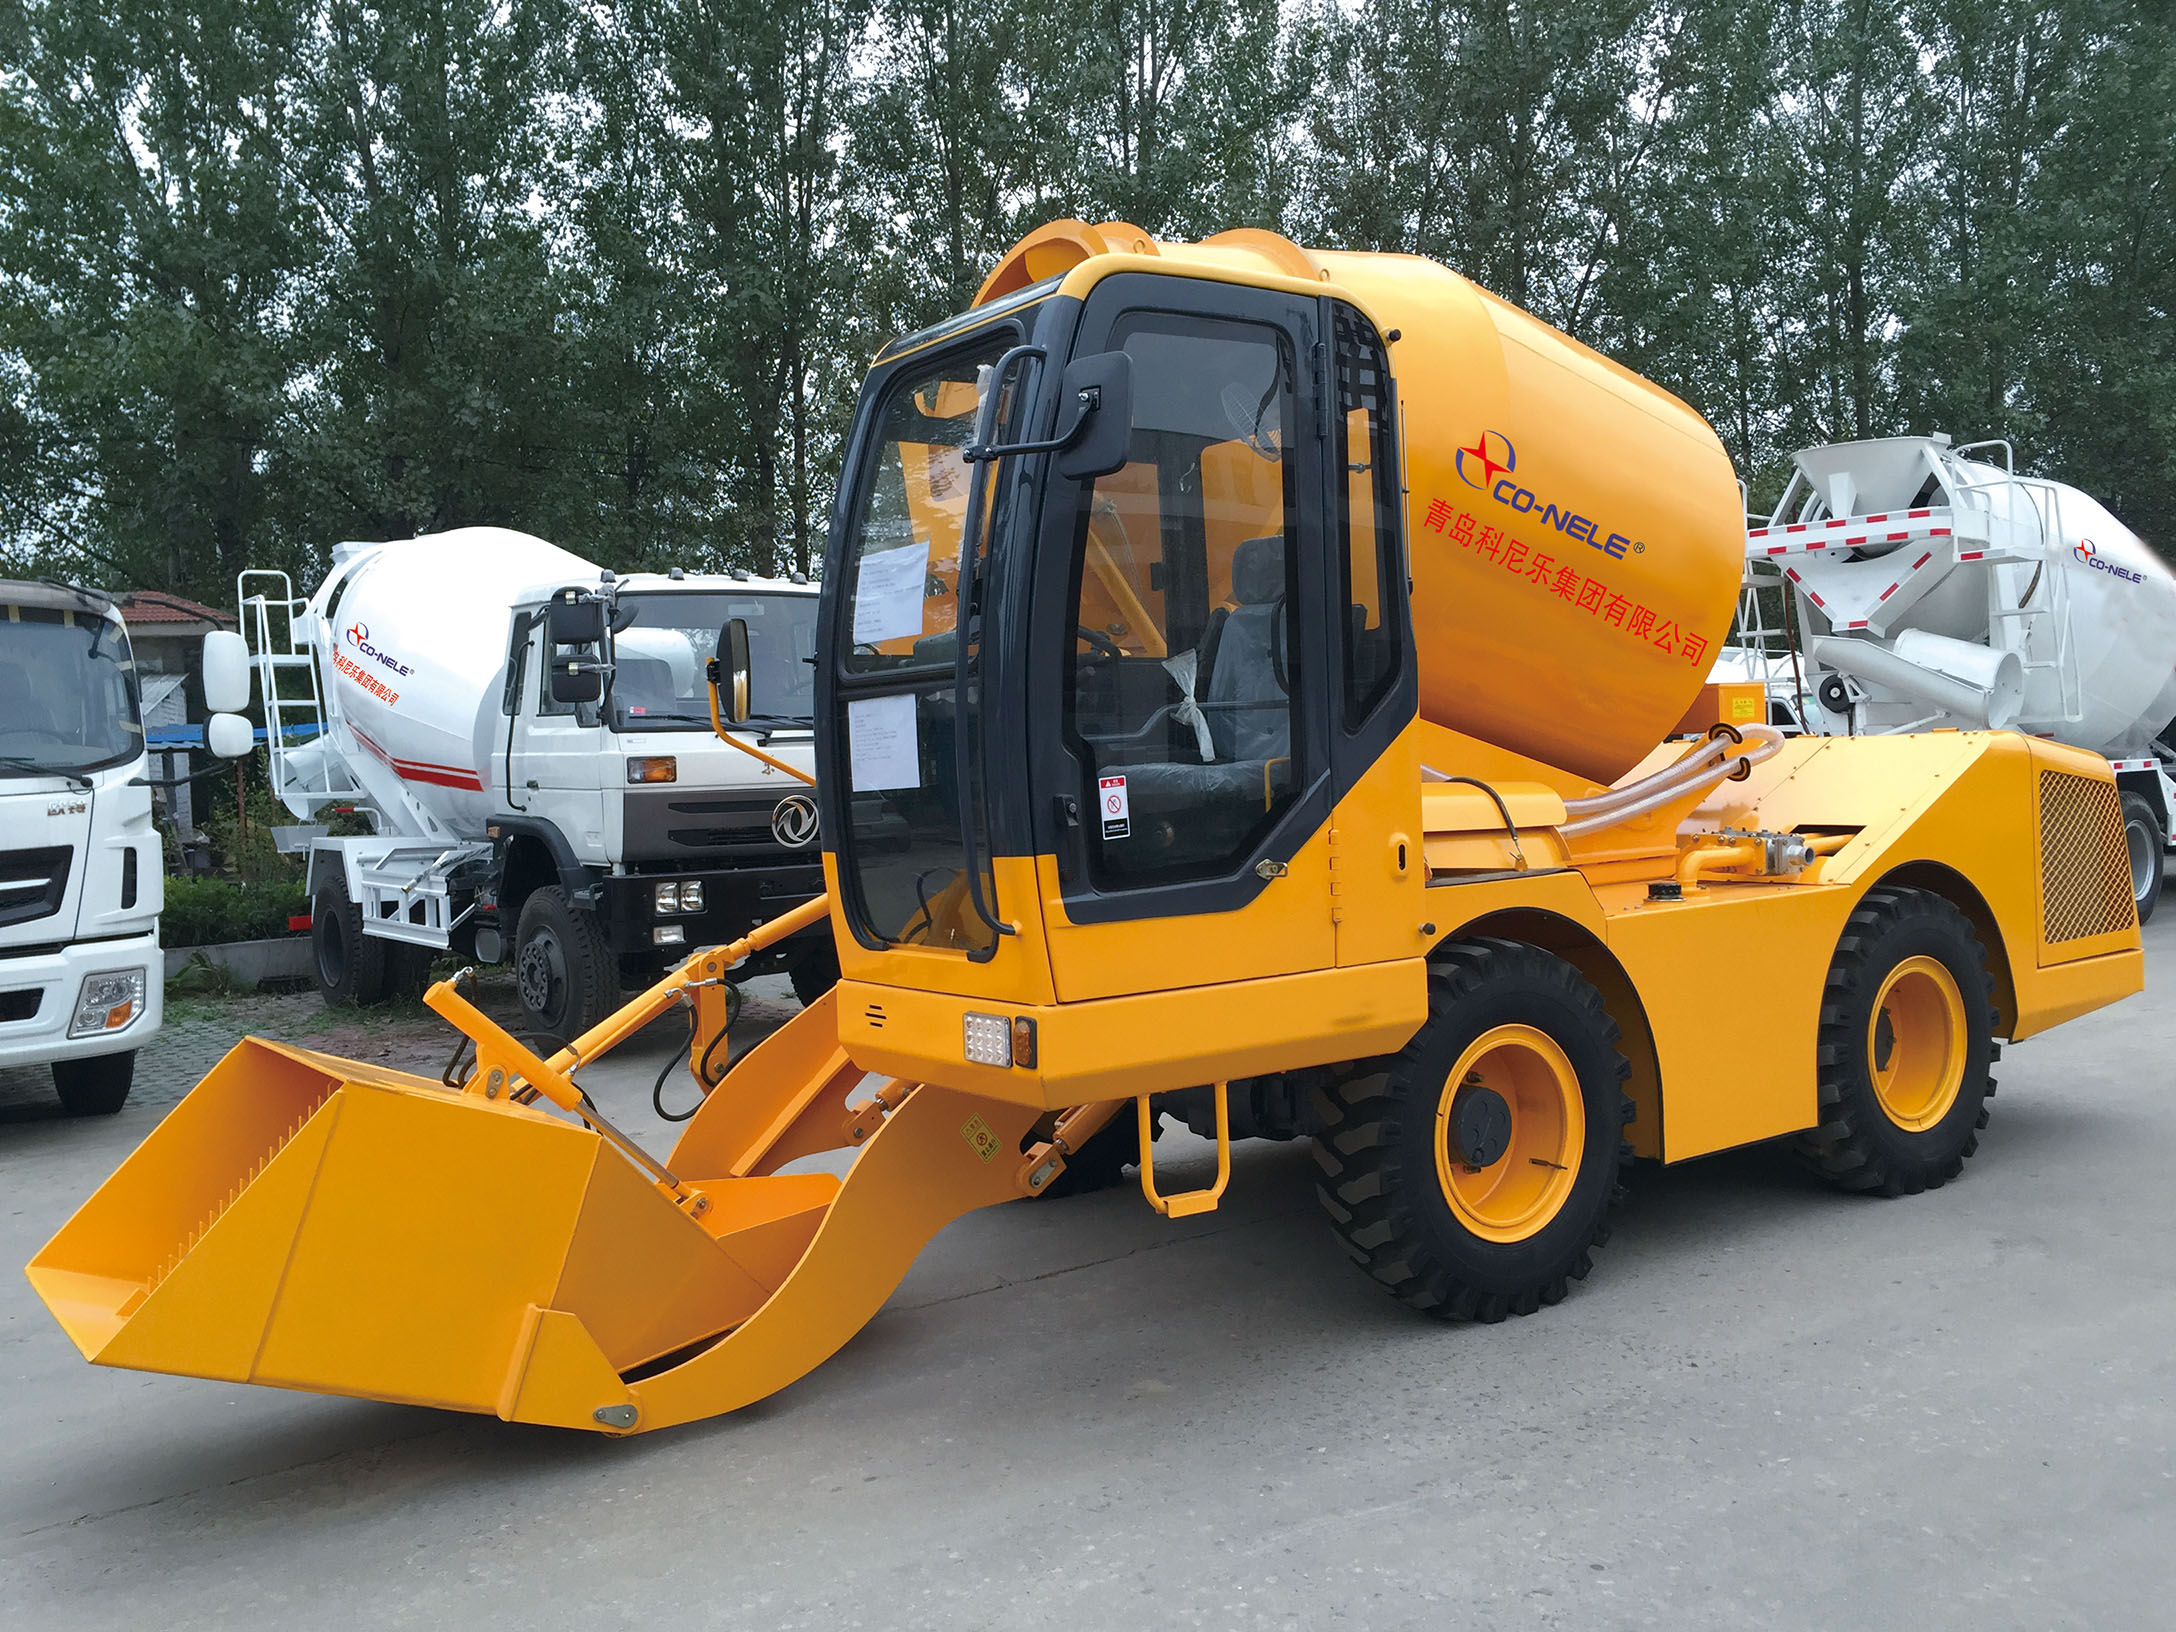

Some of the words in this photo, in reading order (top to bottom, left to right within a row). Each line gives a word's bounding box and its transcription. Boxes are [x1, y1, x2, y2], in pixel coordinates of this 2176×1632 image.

[1423, 497, 1709, 667] 青岛科尼乐集团有限公司
